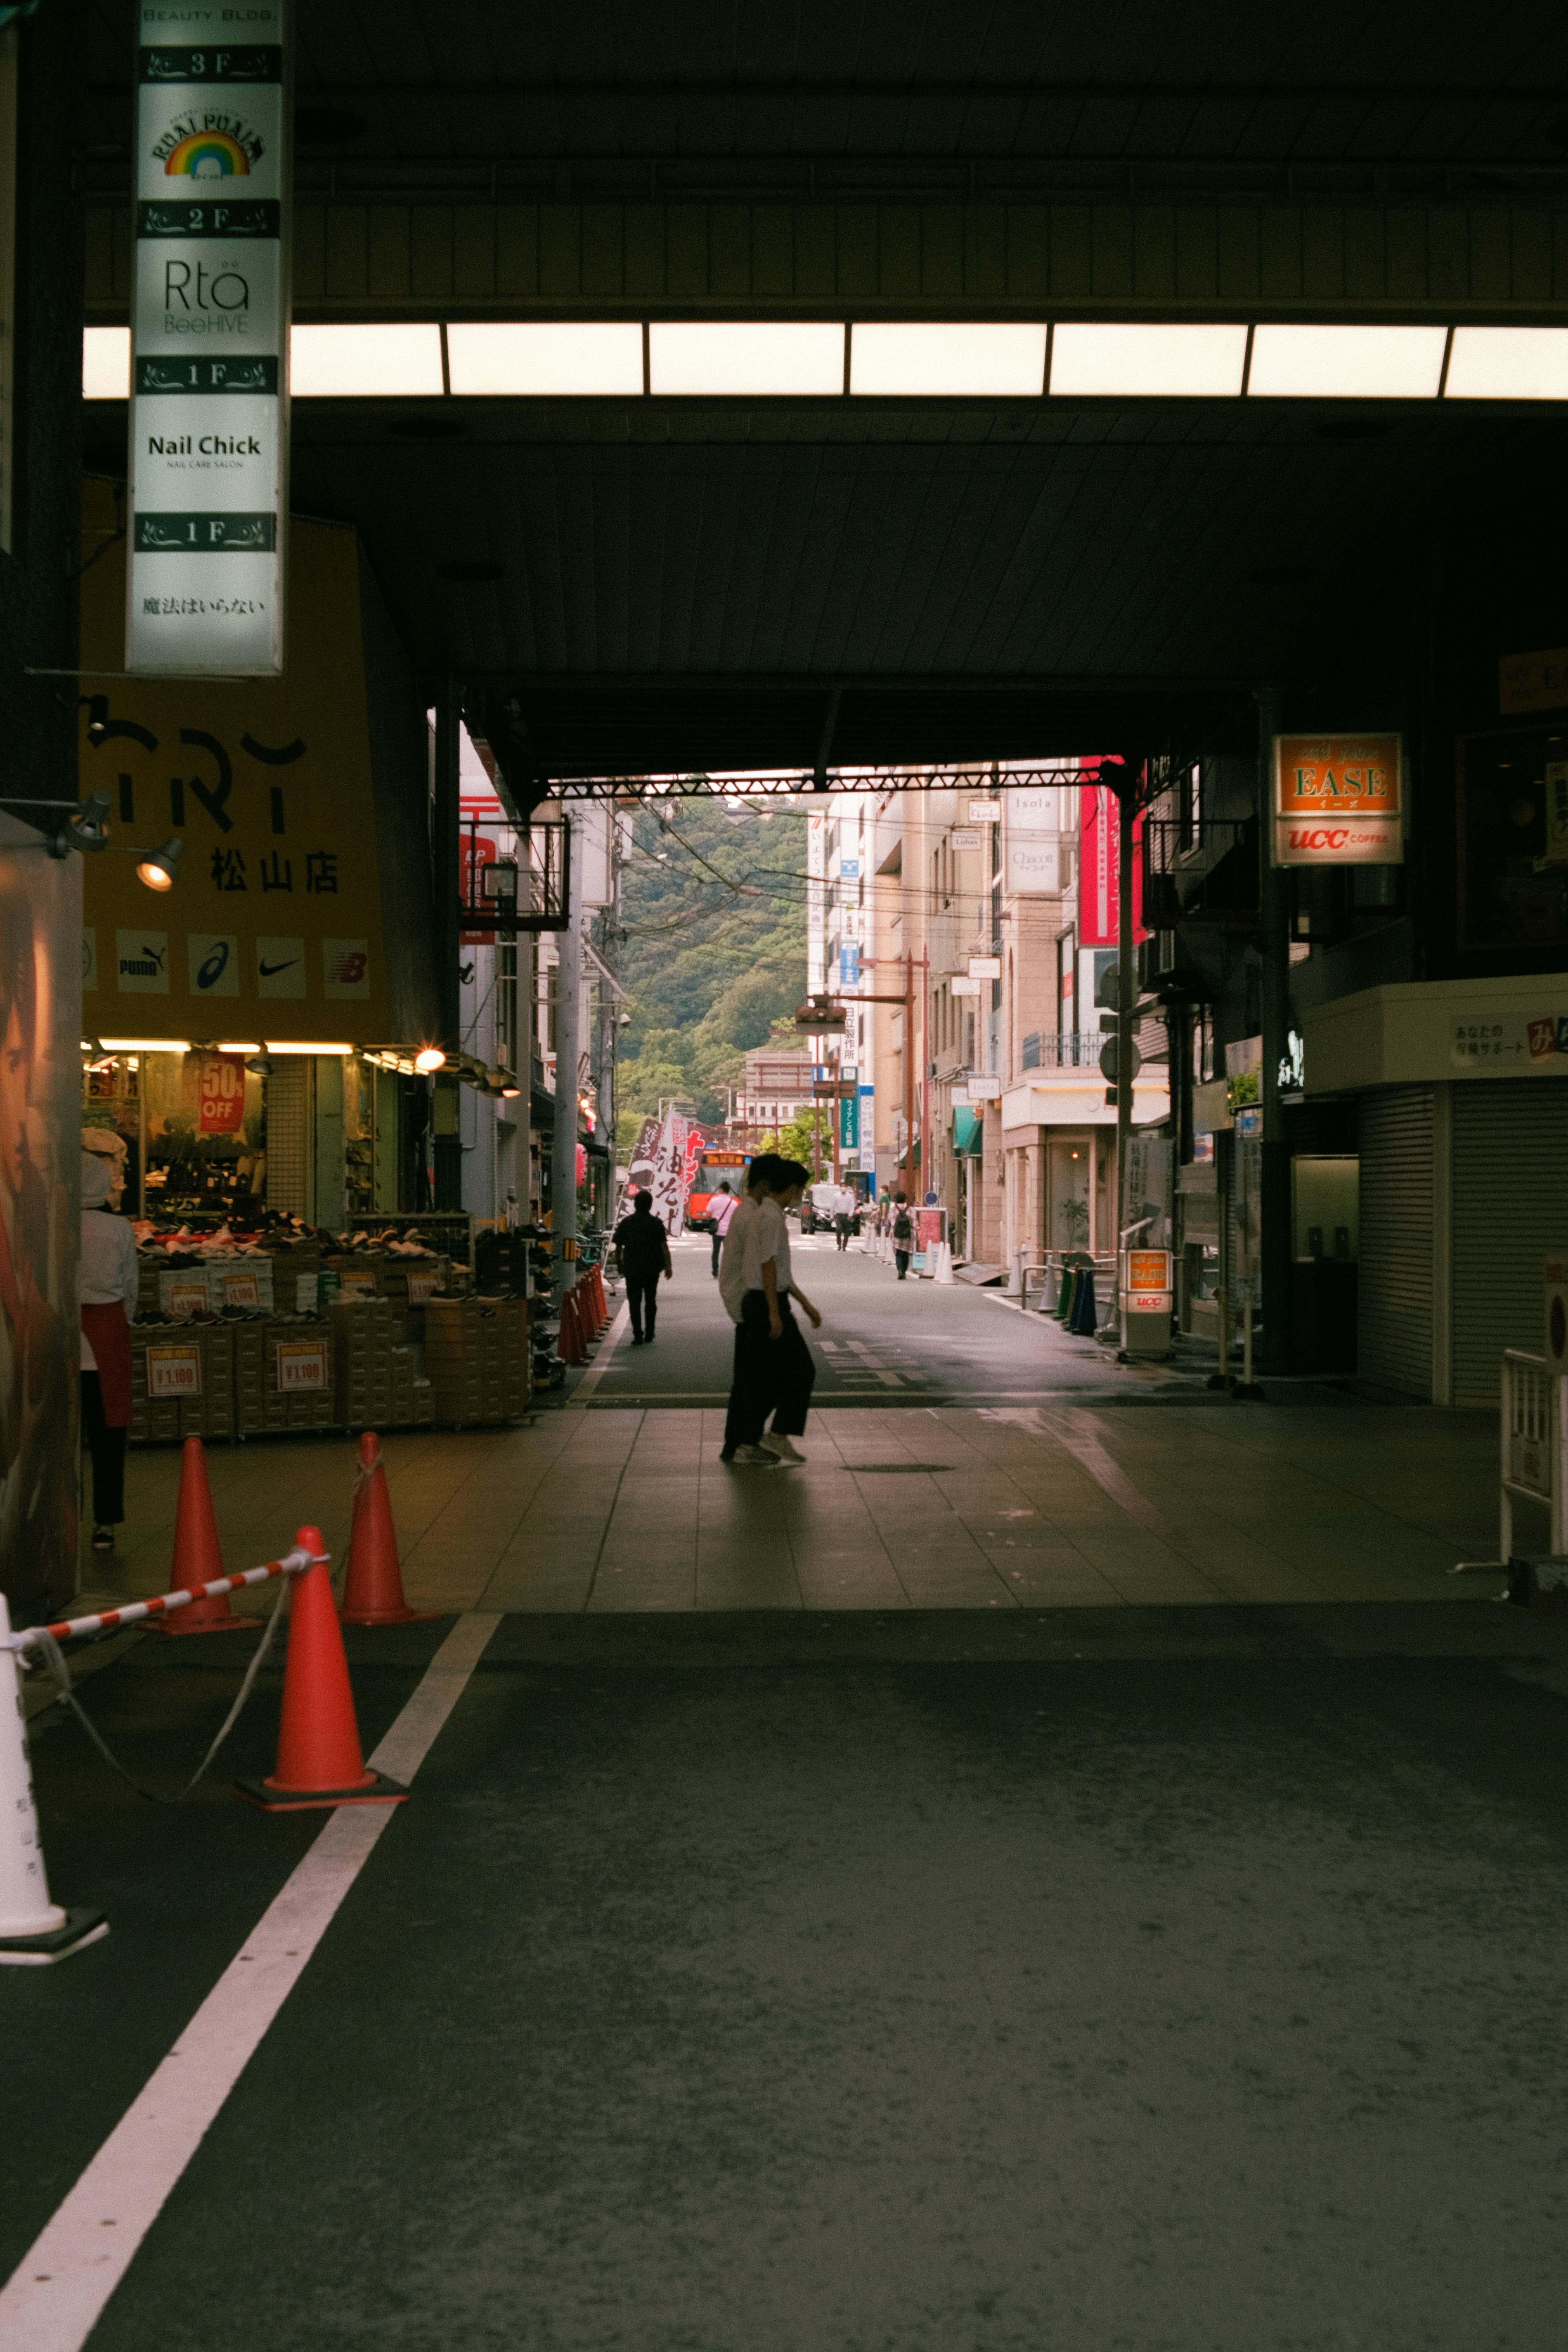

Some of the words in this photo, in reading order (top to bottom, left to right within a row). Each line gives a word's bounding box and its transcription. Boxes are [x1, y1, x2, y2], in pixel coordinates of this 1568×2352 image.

[148, 436, 192, 455] Nail
[199, 435, 261, 455] Chick
[142, 597, 265, 615] 魔法はいらない
[1293, 767, 1387, 797] EASE
[1016, 797, 1050, 808] Isola
[1350, 834, 1388, 843] COFFEE
[211, 847, 338, 894] 松山店
[120, 960, 157, 976] PUMA
[844, 1007, 855, 1060] 日立製作所
[1456, 1025, 1503, 1039] あなたの
[203, 1061, 243, 1099] 50%
[203, 1101, 233, 1118] OFF
